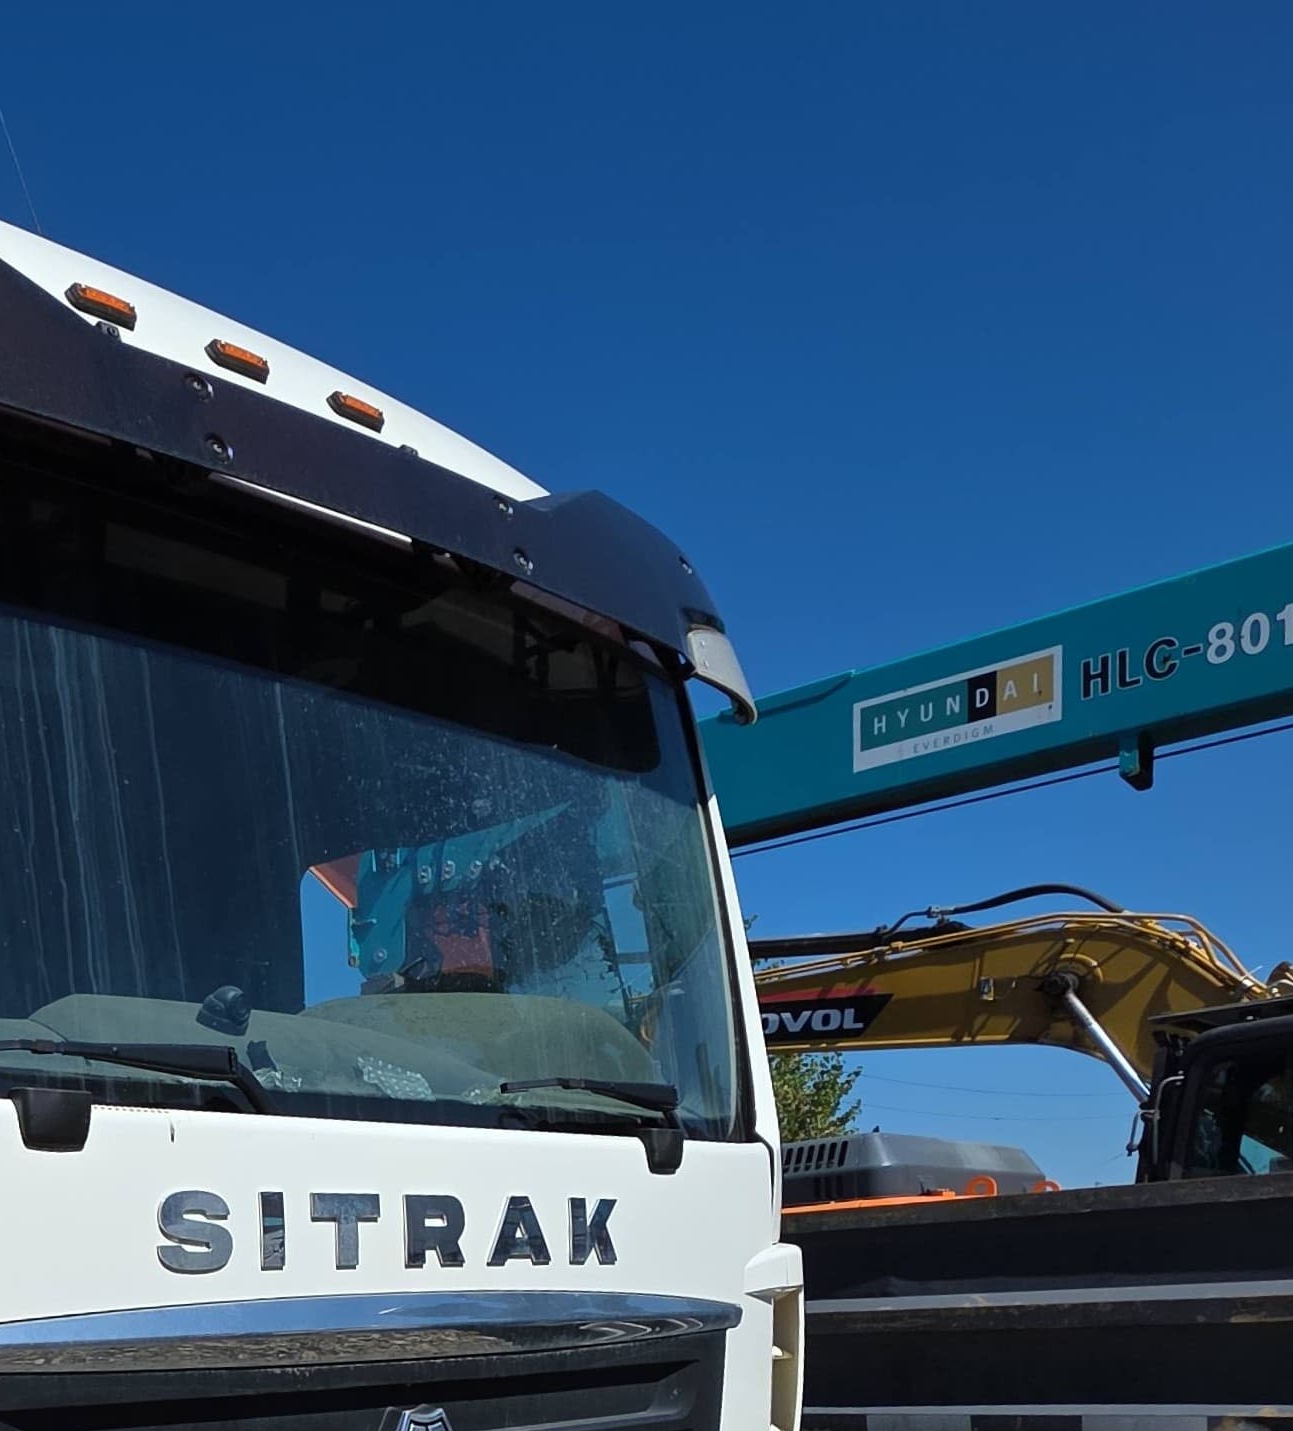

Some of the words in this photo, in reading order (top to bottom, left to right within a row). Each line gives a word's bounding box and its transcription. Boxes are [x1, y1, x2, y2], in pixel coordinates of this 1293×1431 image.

[873, 672, 1040, 735] HYUNDAI
[913, 724, 994, 753] EVERDIGM
[157, 1189, 617, 1275] SITRAK
